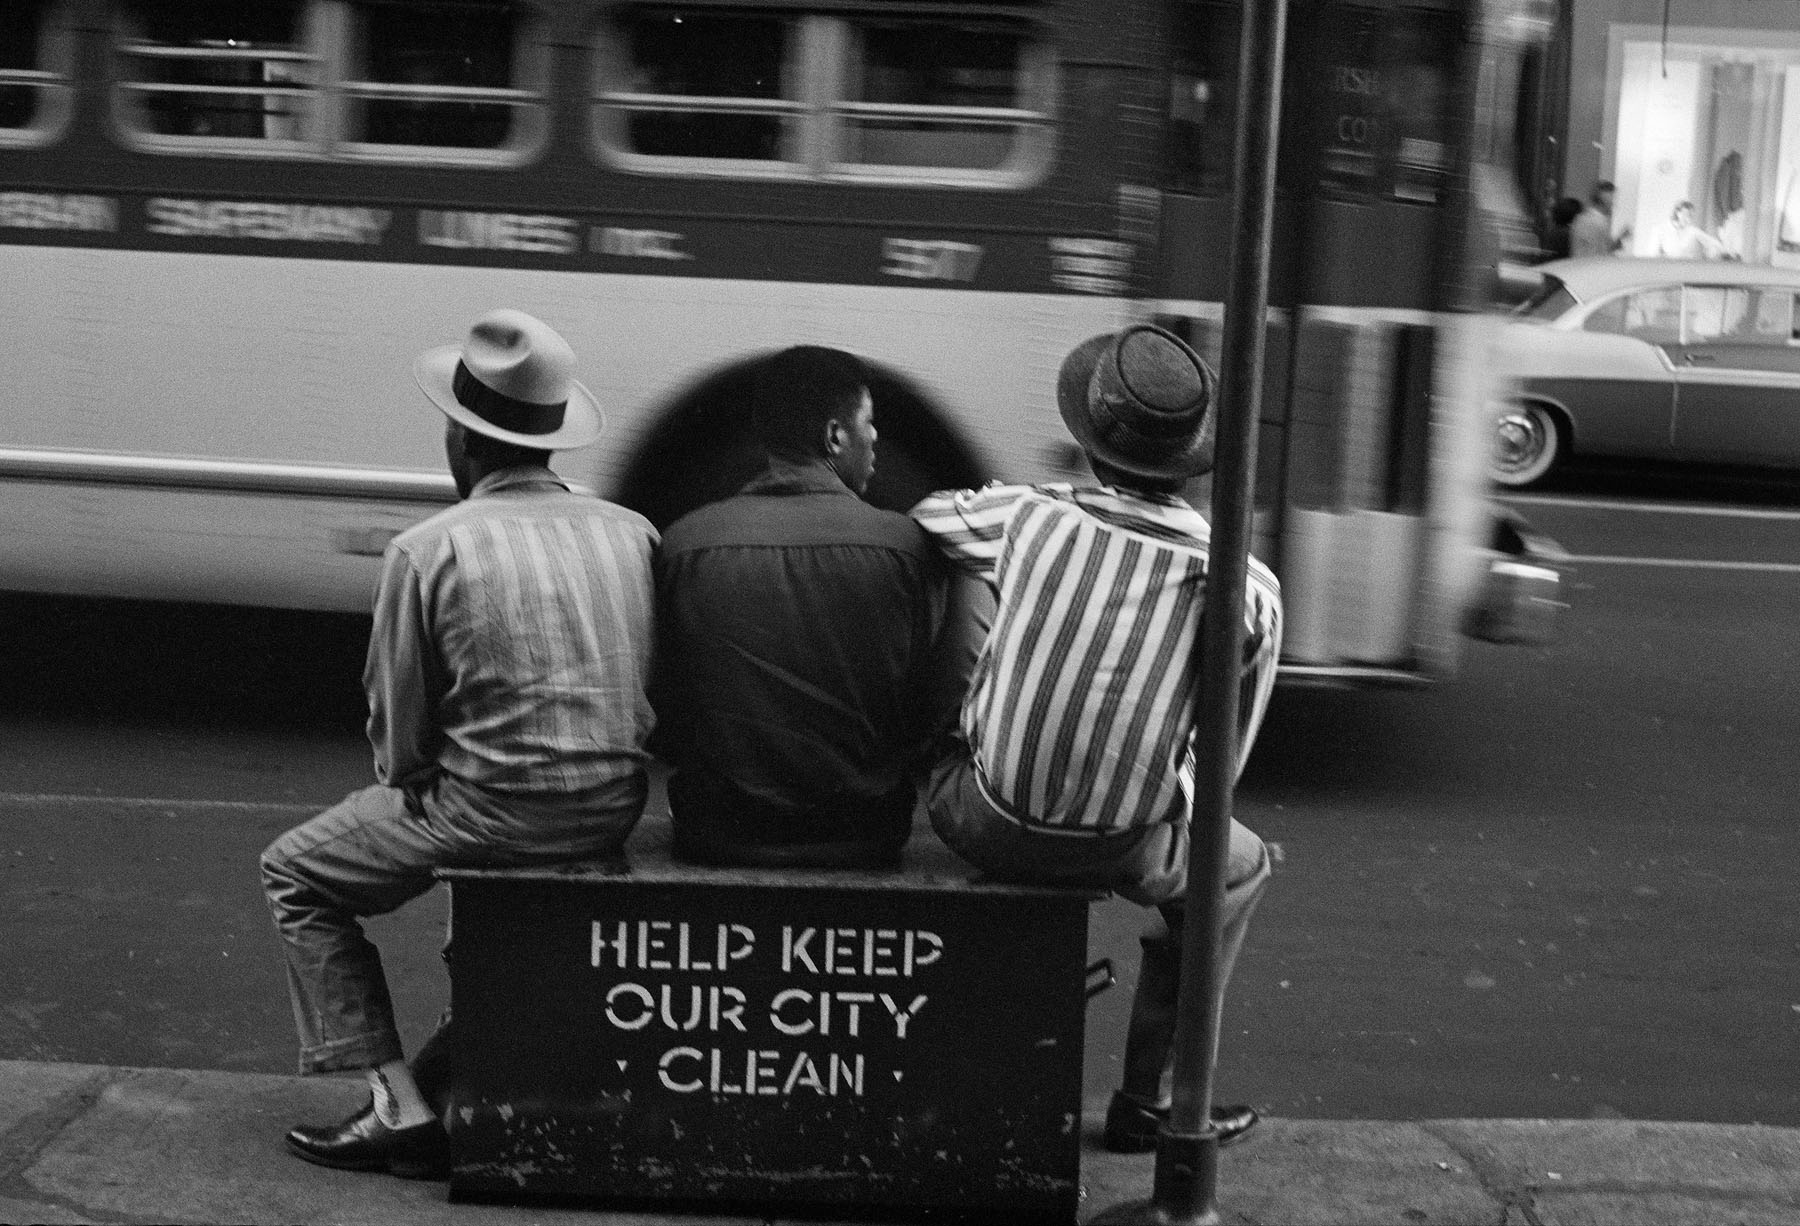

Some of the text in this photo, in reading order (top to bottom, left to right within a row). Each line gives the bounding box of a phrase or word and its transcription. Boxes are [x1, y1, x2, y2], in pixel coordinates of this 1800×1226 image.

[590, 920, 944, 977] HELP KEEP
[605, 982, 929, 1039] OUR CITY
[657, 1046, 865, 1097] CLEAN
